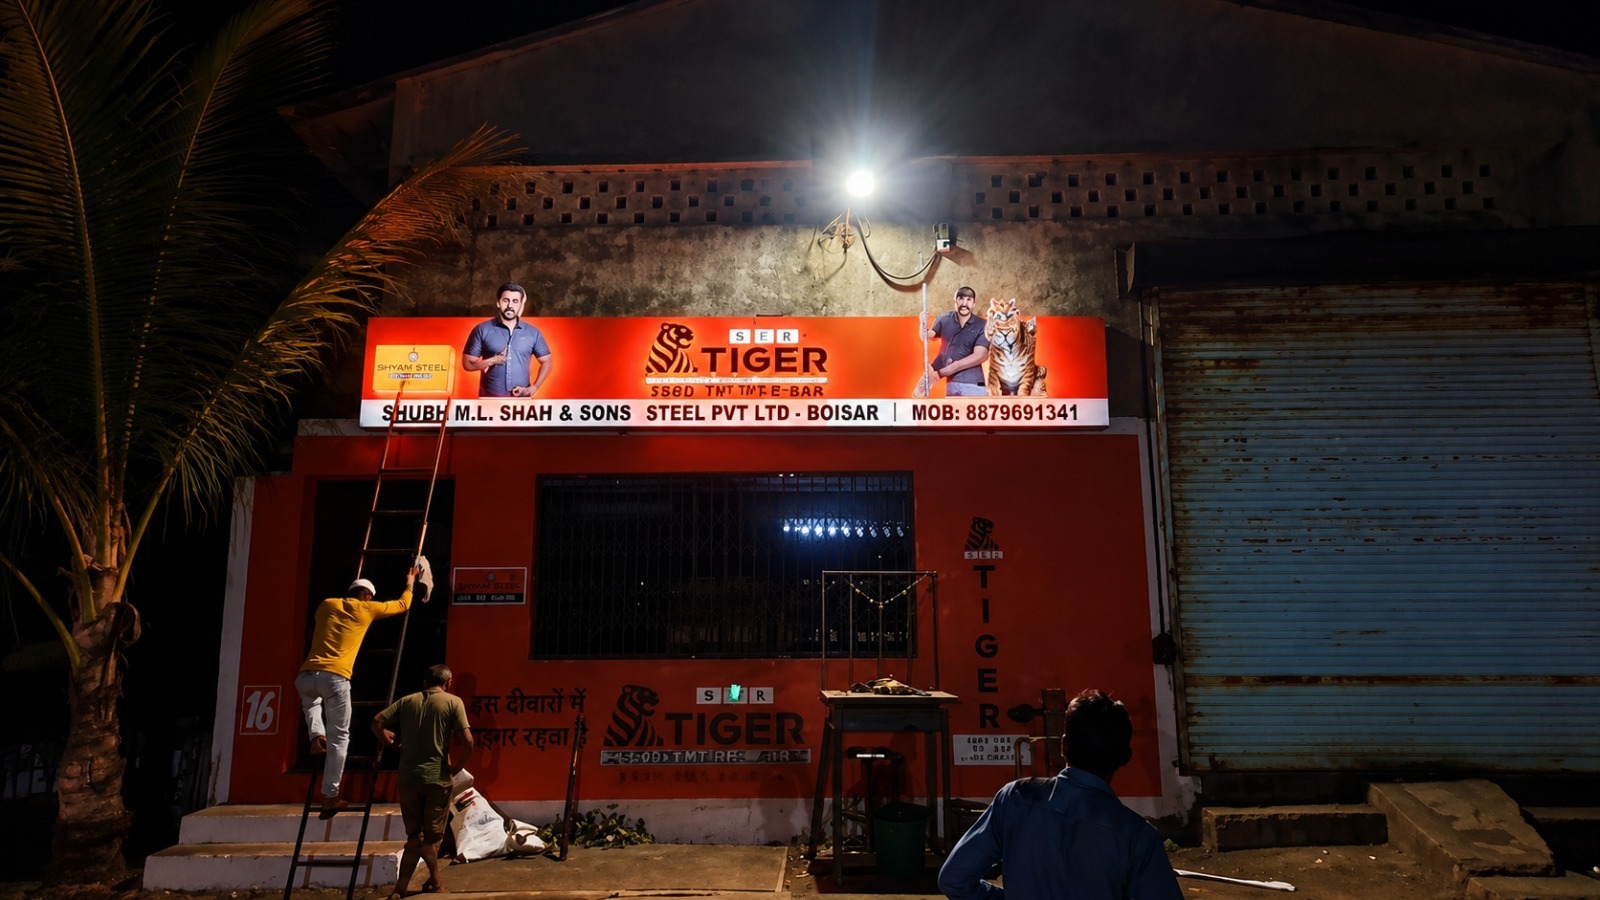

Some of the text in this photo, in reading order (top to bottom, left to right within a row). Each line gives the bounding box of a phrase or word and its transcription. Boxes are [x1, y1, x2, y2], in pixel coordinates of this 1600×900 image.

[701, 347, 827, 373] TIGER
[382, 405, 449, 421] SHUBH
[455, 405, 493, 421] M.L.
[500, 405, 552, 421] SHAH
[559, 405, 573, 421] &
[580, 405, 631, 421] SONS
[647, 405, 705, 421] STEEL
[712, 405, 748, 421] PVT
[755, 405, 789, 421] LTD
[808, 404, 879, 421] BOISAR
[912, 404, 960, 420] MOB:
[966, 404, 1078, 420] 8879691341
[973, 565, 1000, 729] TIGER
[245, 690, 276, 731] 16
[471, 688, 587, 718] इस दीवारों में
[704, 690, 766, 702] SR
[665, 713, 805, 746] TIGER
